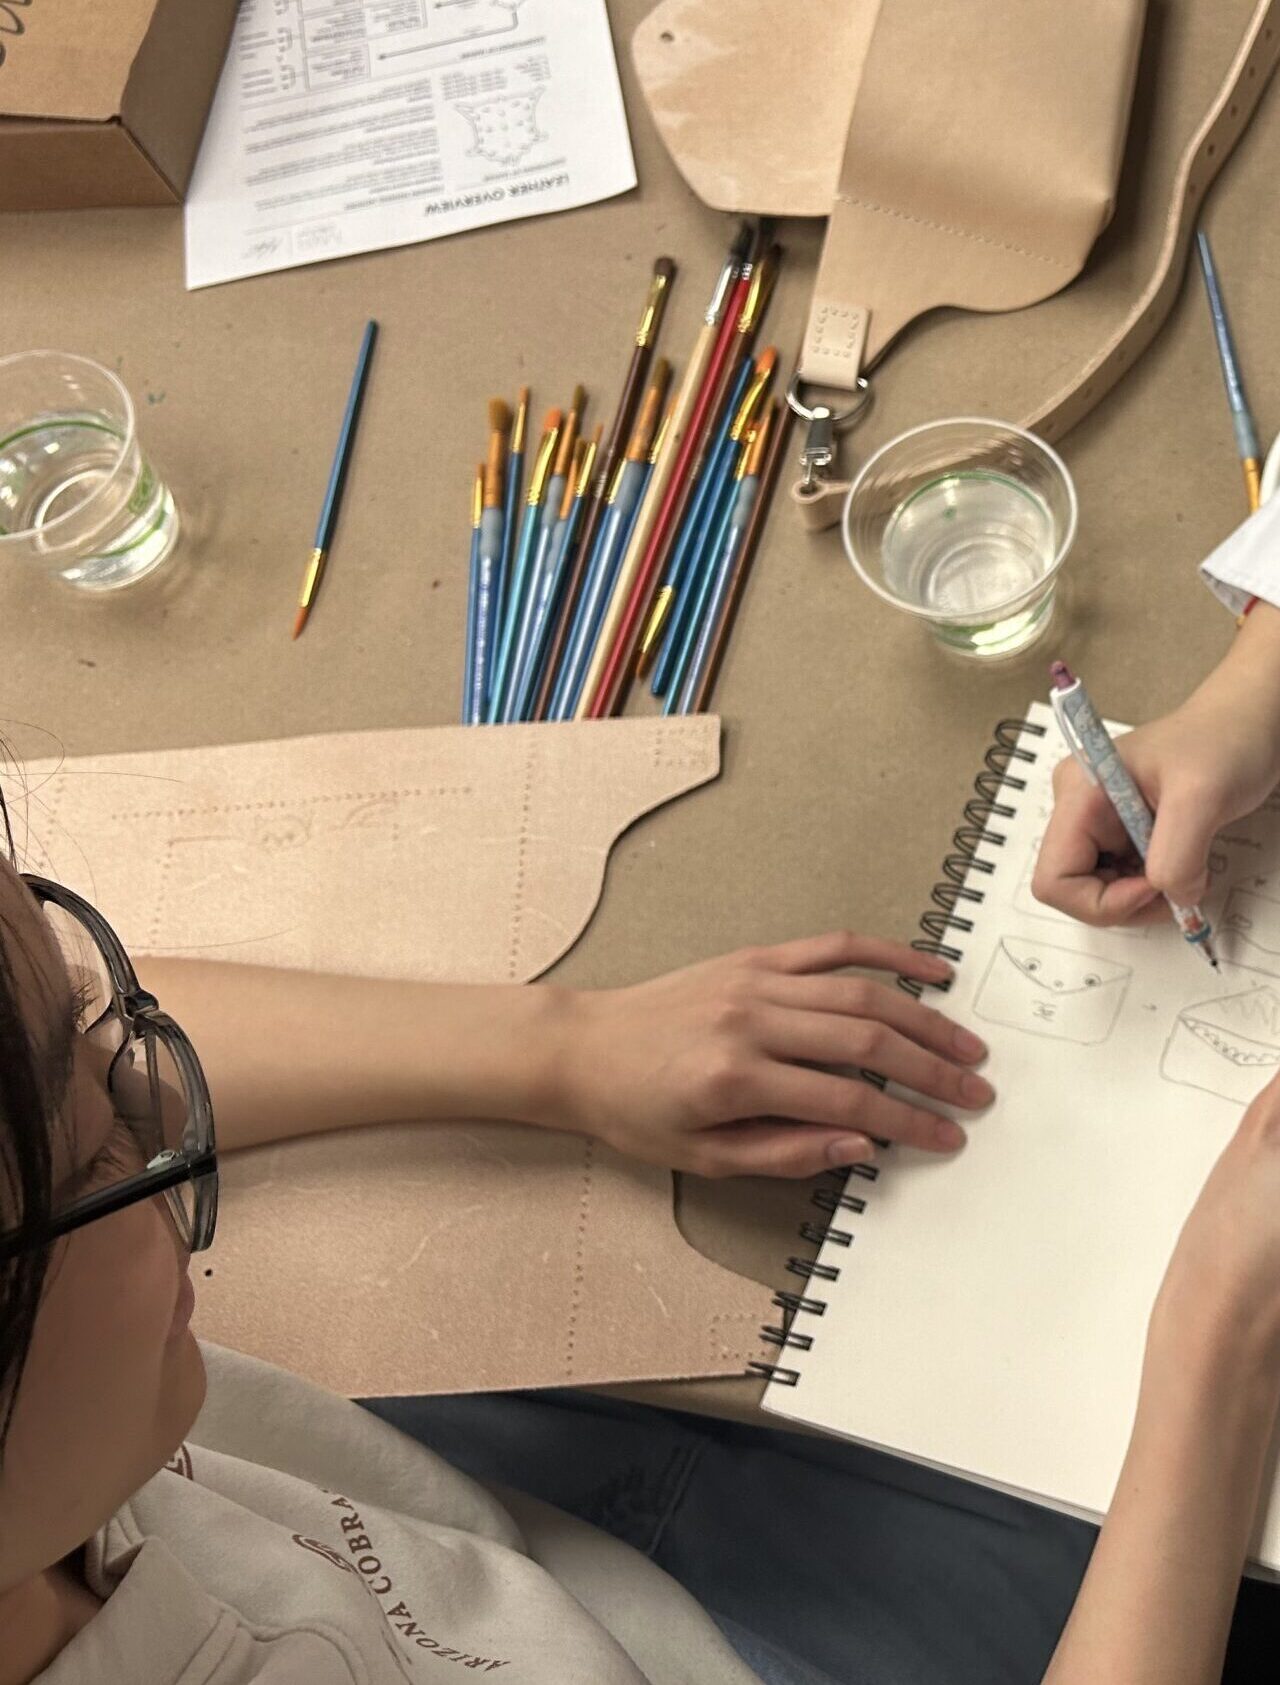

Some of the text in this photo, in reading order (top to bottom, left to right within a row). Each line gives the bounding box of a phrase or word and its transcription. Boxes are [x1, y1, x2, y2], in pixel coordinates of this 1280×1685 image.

[508, 172, 570, 198] LEATHER
[424, 187, 506, 217] OVERVIEW
[386, 1601, 510, 1671] ARIZONA
